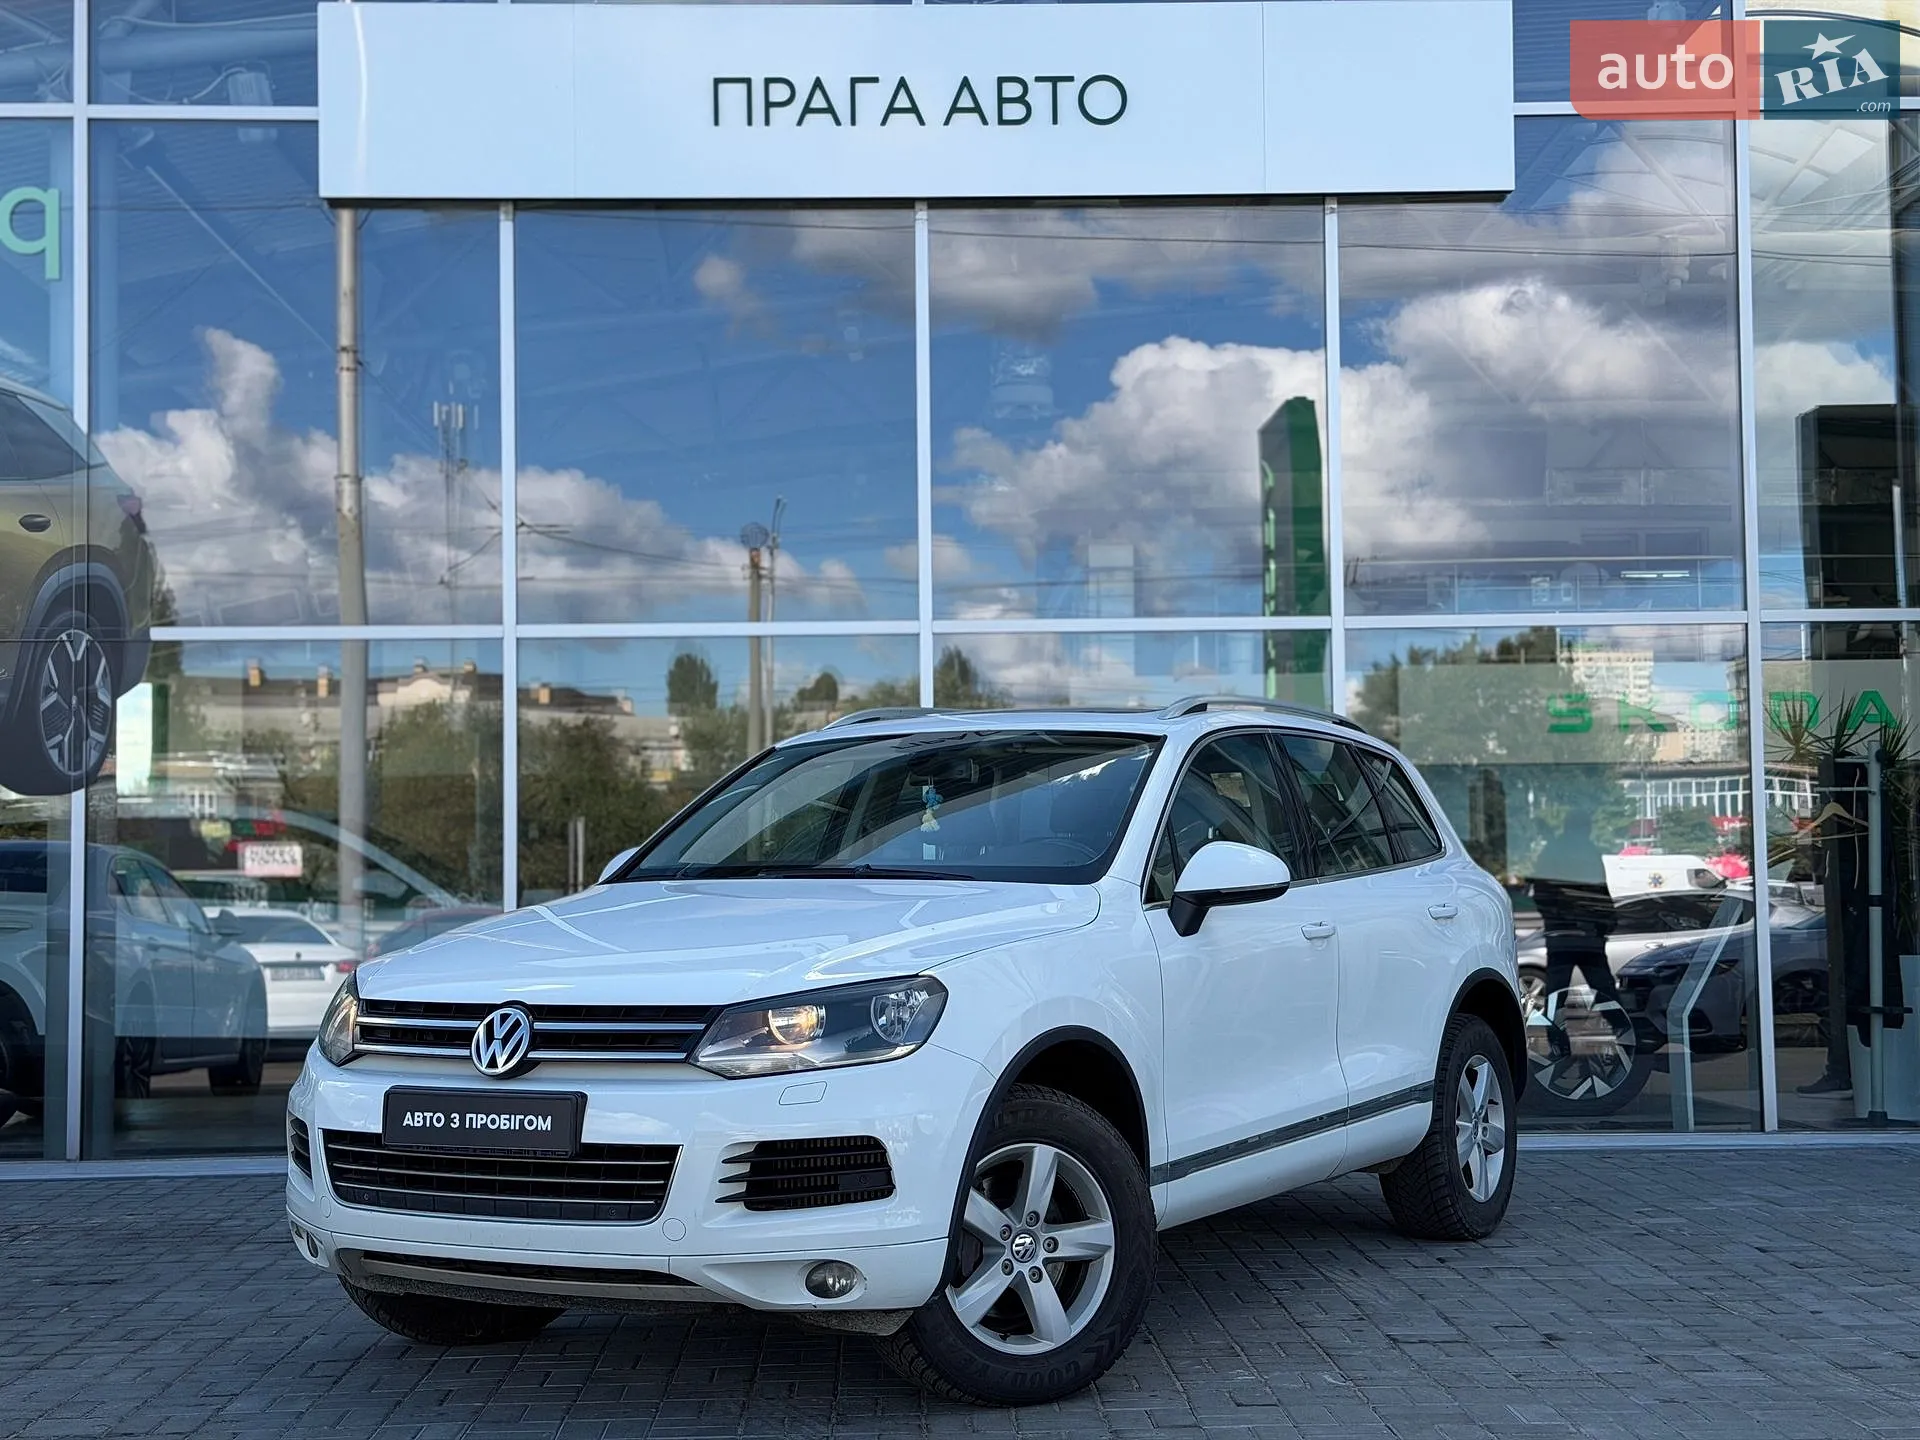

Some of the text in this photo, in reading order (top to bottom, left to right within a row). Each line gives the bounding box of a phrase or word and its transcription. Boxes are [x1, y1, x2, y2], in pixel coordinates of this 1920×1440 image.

[712, 74, 1128, 127] ПРАГА АВТО
[402, 1111, 445, 1128] АВТО
[465, 1113, 552, 1131] ПРОБІГОМ
